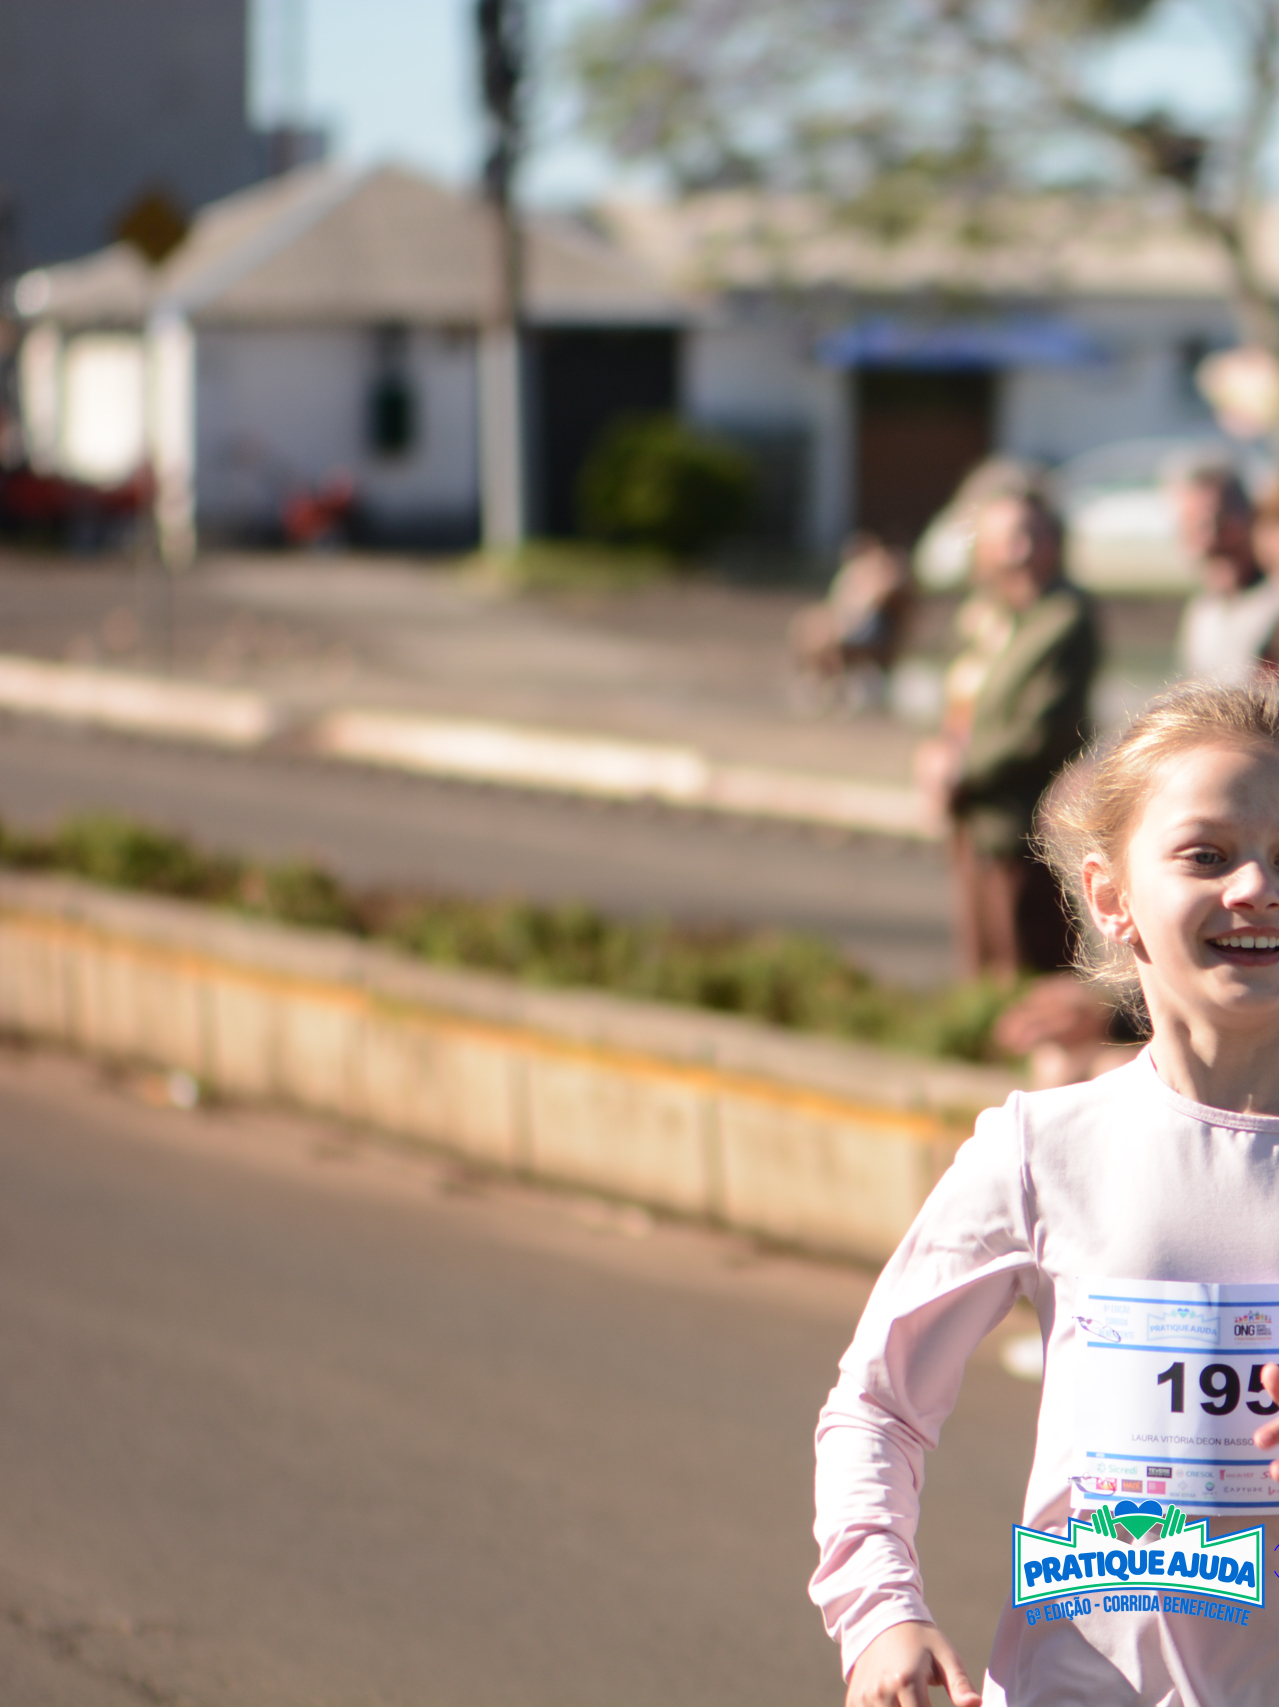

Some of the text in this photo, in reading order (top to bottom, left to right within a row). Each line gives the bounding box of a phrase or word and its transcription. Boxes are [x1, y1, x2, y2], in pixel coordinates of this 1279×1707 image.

[1150, 1324, 1218, 1336] PRATIQUE AJUDA
[1234, 1324, 1255, 1336] ONG
[1131, 1434, 1159, 1443] LAURA
[1160, 1434, 1195, 1444] VITÓRIA
[1196, 1437, 1222, 1446] DEON
[1224, 1438, 1254, 1447] BASSO
[1108, 1464, 1138, 1475] Sicredi
[1186, 1470, 1214, 1478] CRESOL
